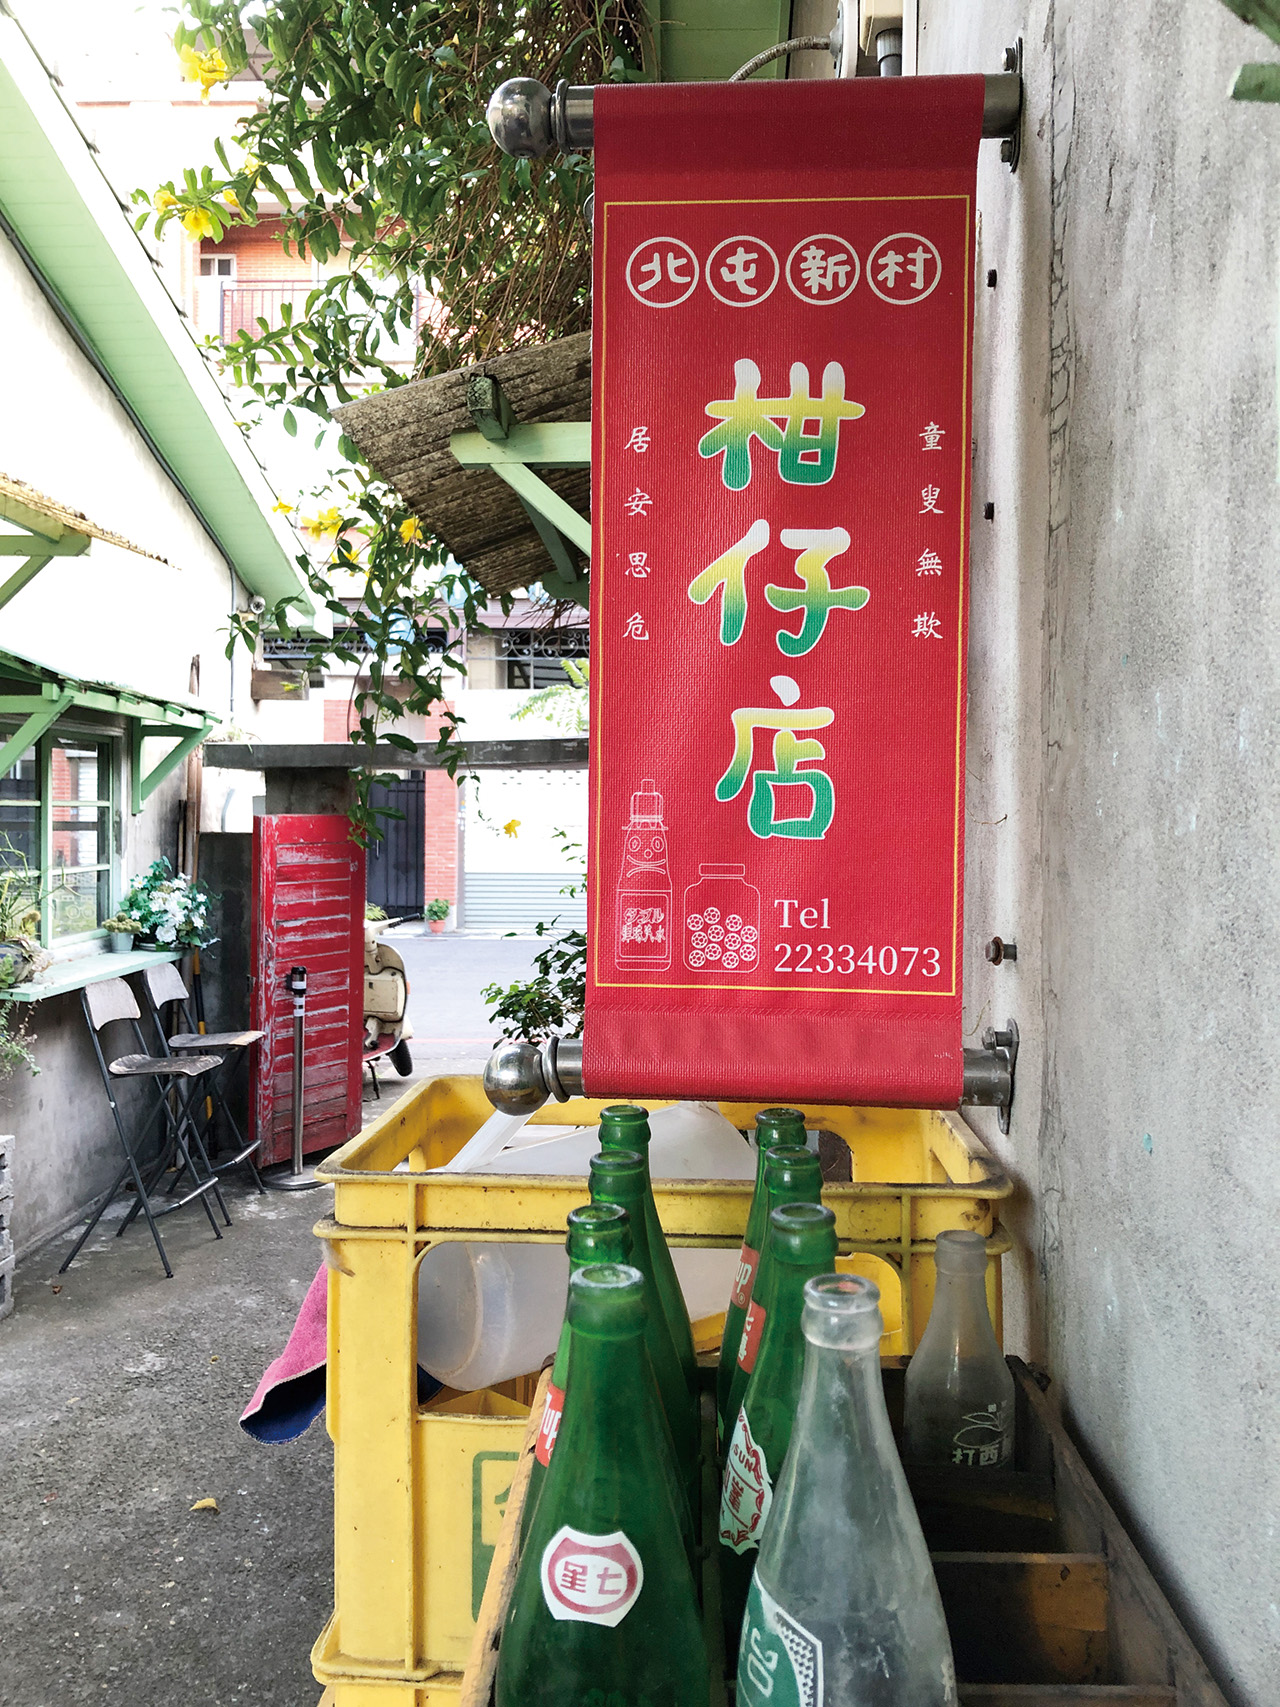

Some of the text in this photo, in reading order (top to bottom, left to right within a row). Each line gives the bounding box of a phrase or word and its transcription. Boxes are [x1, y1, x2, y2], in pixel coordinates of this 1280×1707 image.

[637, 245, 933, 296] 北屯新村
[622, 425, 653, 642] 居安思危
[911, 420, 946, 640] 童叟無欺
[688, 358, 871, 840] 柑仔店
[774, 898, 831, 930] Tel
[774, 942, 942, 977] 22334073
